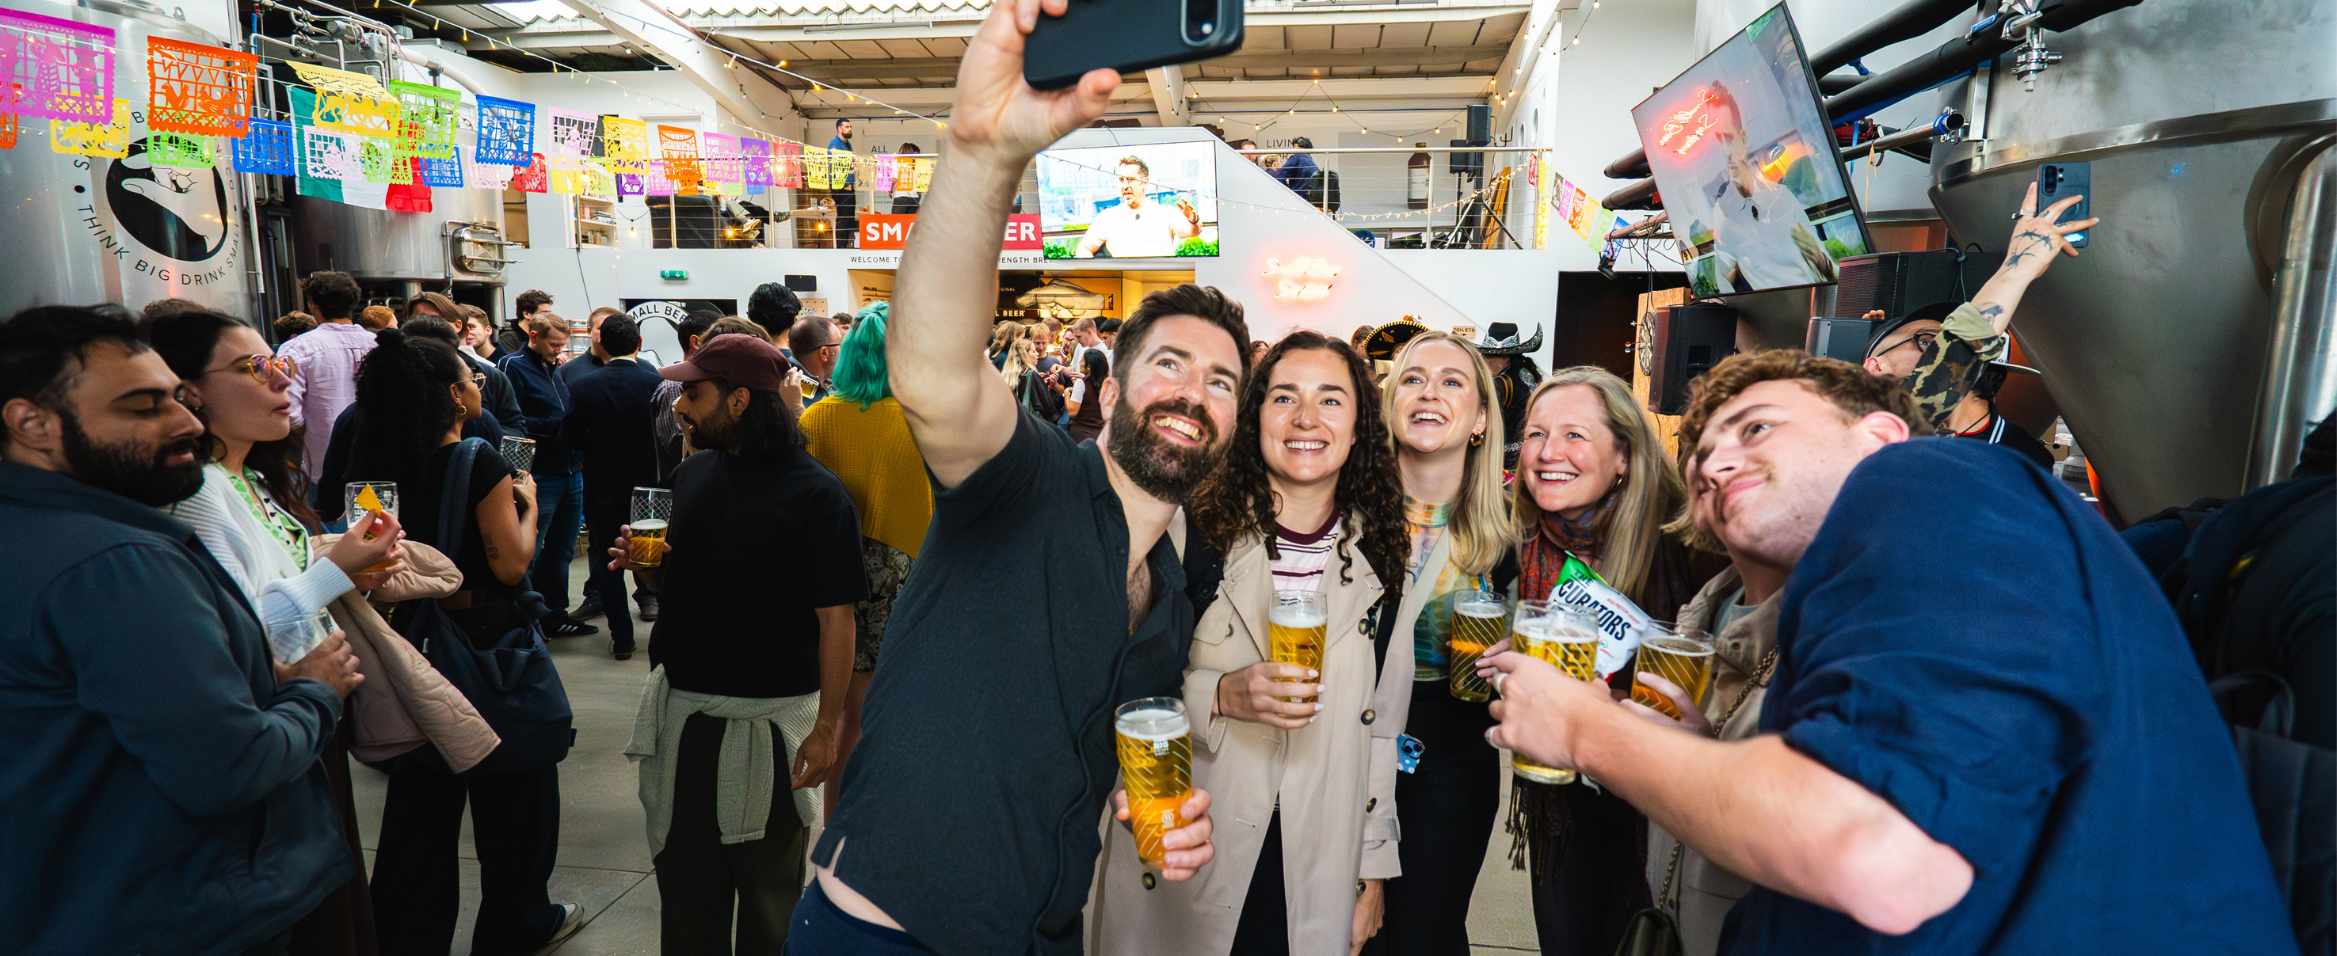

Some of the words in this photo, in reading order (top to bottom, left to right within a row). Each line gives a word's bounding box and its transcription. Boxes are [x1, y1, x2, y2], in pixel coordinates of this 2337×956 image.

[871, 145, 888, 153] ALL
[1266, 139, 1293, 148] LIVIN
[1003, 222, 1037, 242] ER
[78, 204, 131, 260] THINK
[134, 259, 171, 282] BIG
[181, 265, 227, 286] DRINK
[632, 304, 660, 320] MALL
[1002, 309, 1025, 317] BEER
[1575, 568, 1594, 587] THE
[1558, 578, 1632, 641] CURATORS
